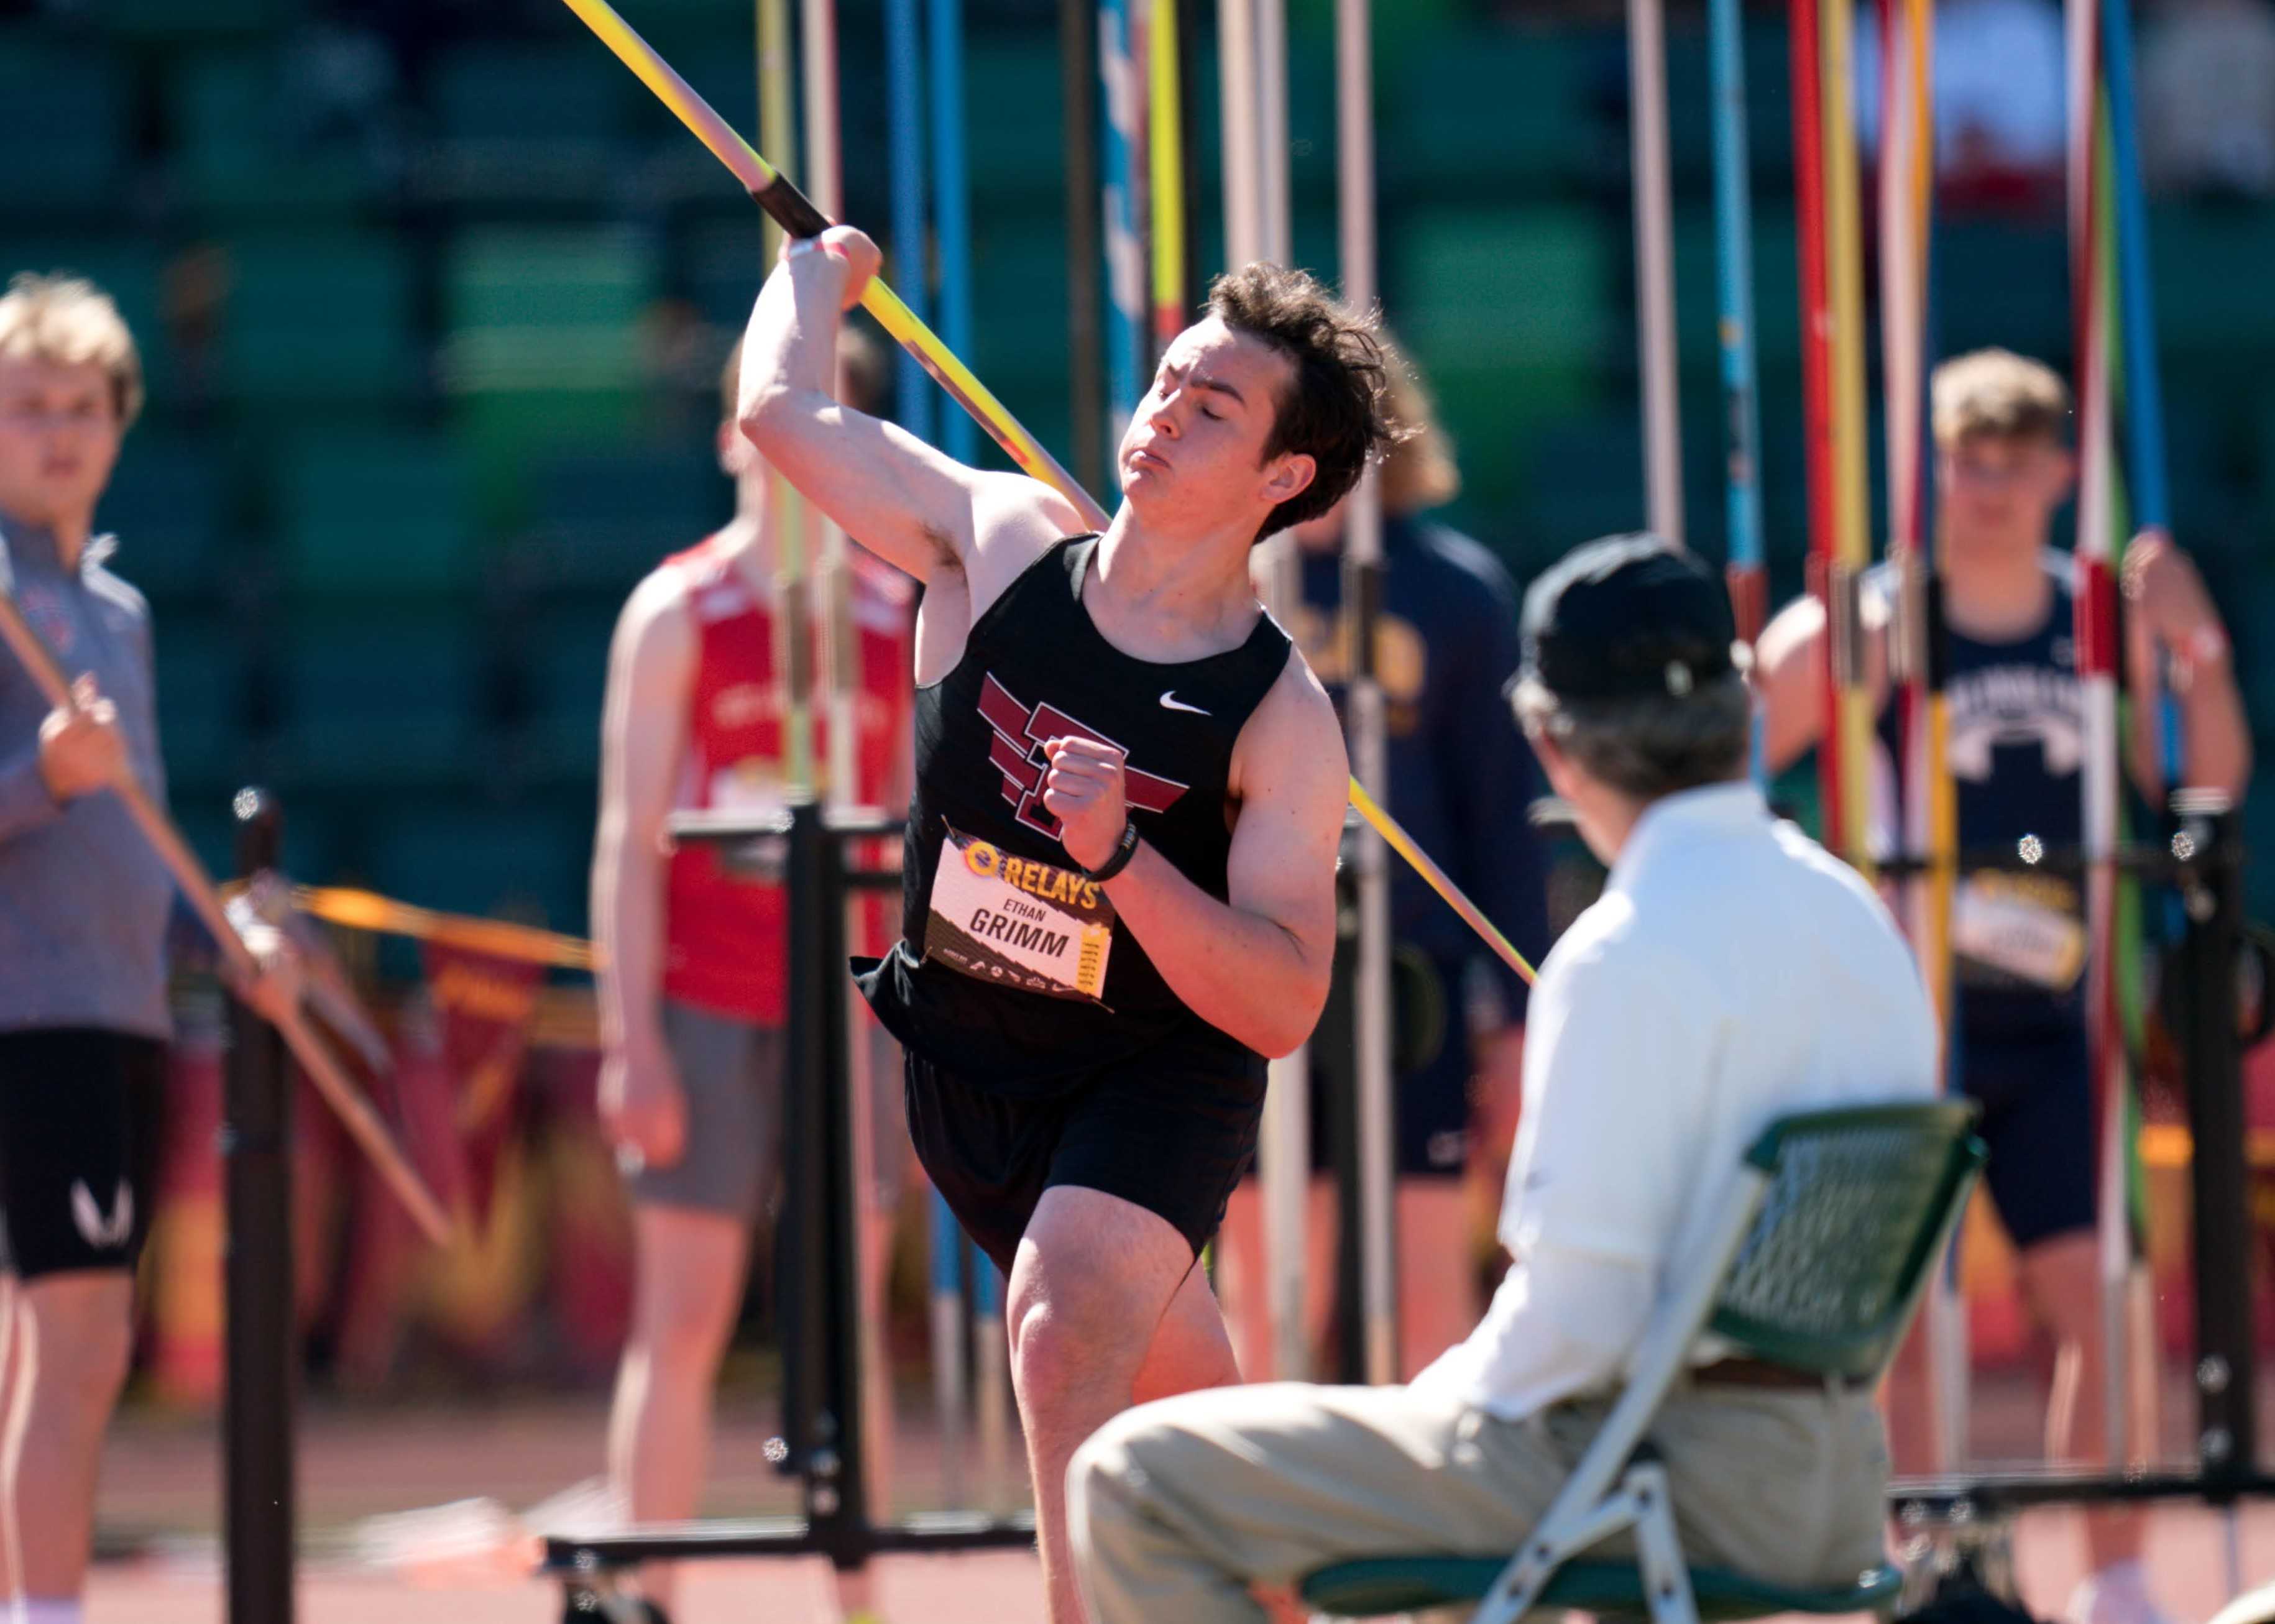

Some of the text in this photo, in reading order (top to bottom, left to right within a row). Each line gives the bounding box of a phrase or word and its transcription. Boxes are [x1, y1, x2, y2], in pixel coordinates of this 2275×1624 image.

[1003, 856, 1100, 909] RELAYS
[970, 908, 1070, 958] GRIMM
[1003, 898, 1046, 922] ETHAN
